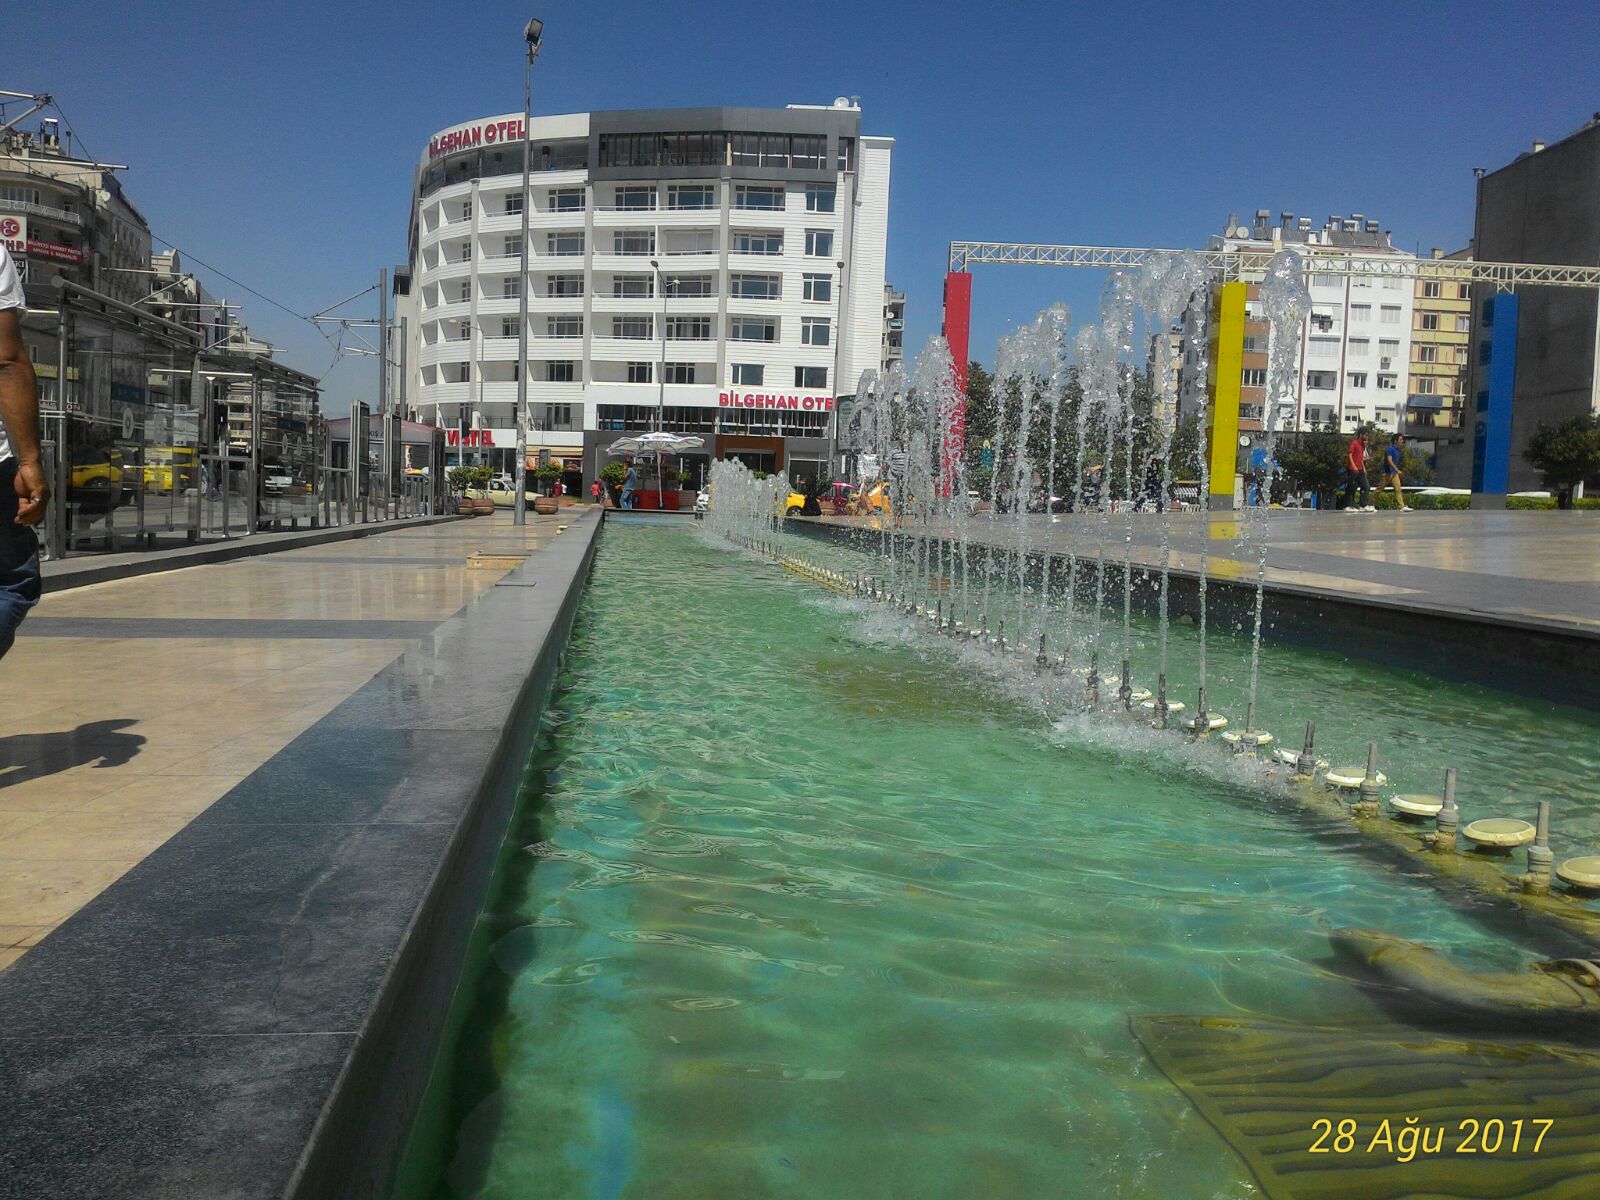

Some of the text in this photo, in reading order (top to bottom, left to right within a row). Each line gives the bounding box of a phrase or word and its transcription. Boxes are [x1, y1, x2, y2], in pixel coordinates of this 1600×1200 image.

[429, 120, 526, 159] BİLGEHAN OTEL
[0, 240, 25, 251] HP
[719, 389, 798, 410] BİLGEHAN
